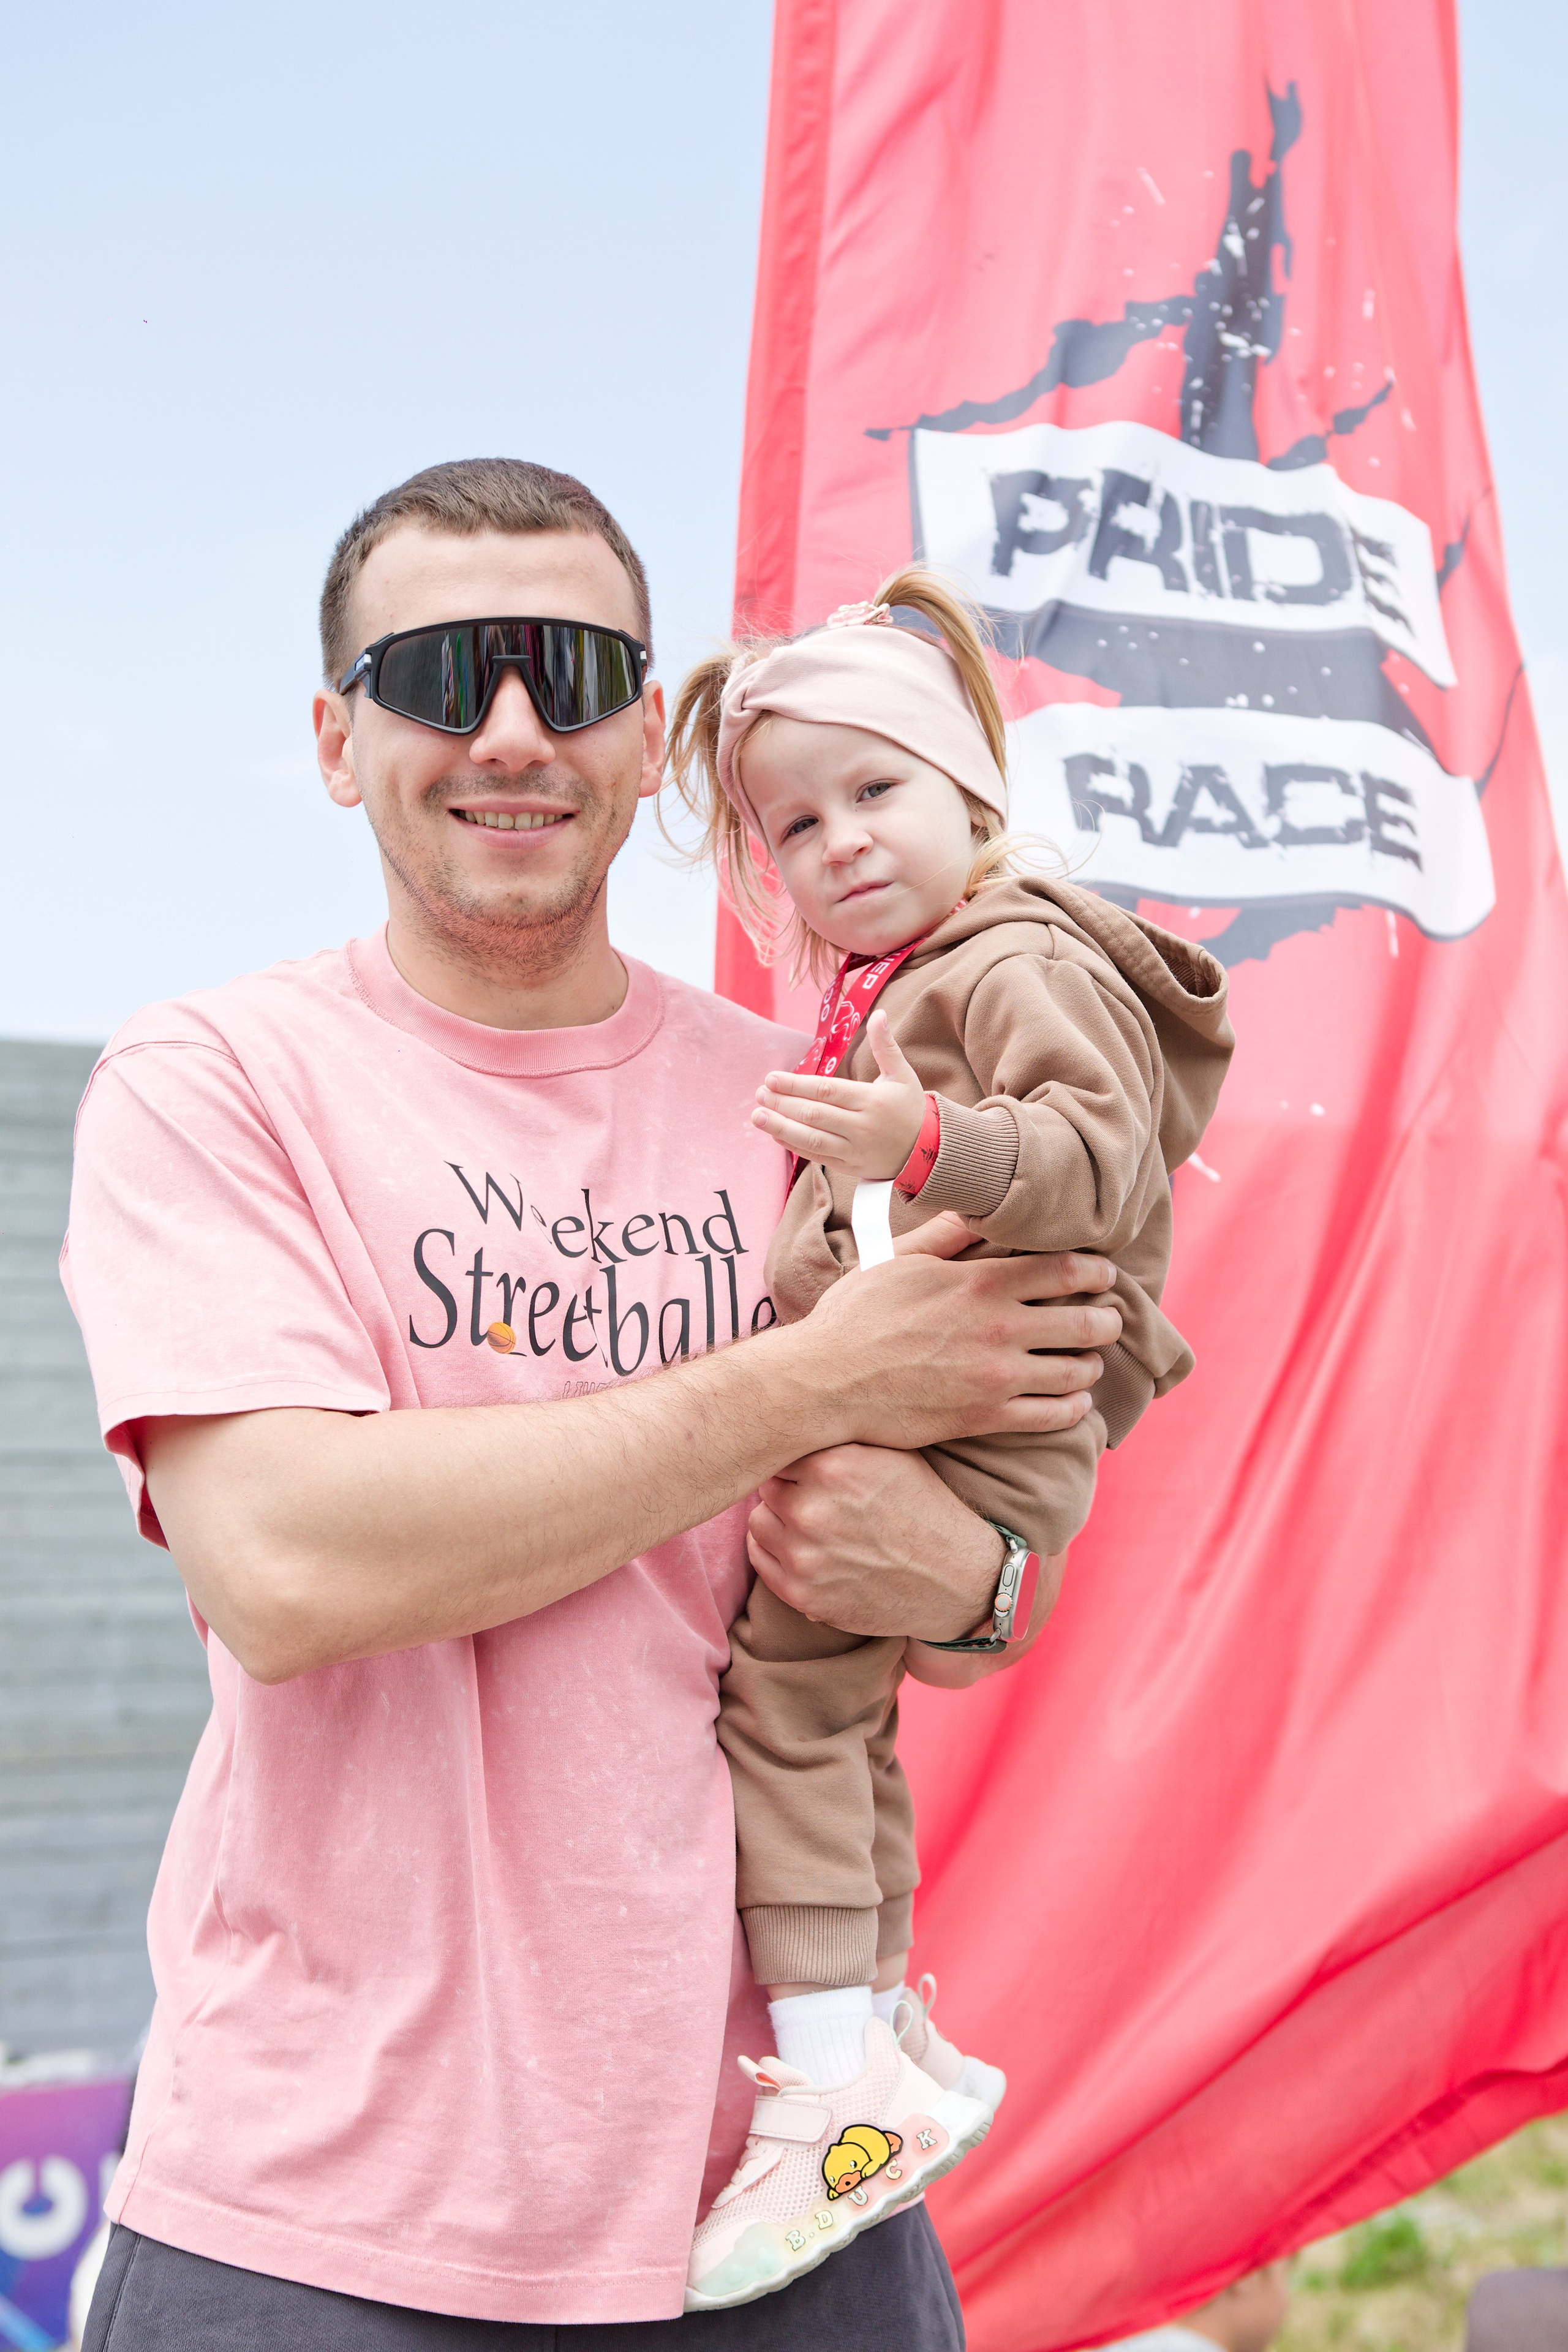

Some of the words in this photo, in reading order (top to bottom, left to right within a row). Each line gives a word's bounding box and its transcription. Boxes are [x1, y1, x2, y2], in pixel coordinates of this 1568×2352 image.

[987, 468, 1416, 637] PRIDE
[1063, 751, 1423, 873] RACE
[443, 1160, 749, 1263] Weekend
